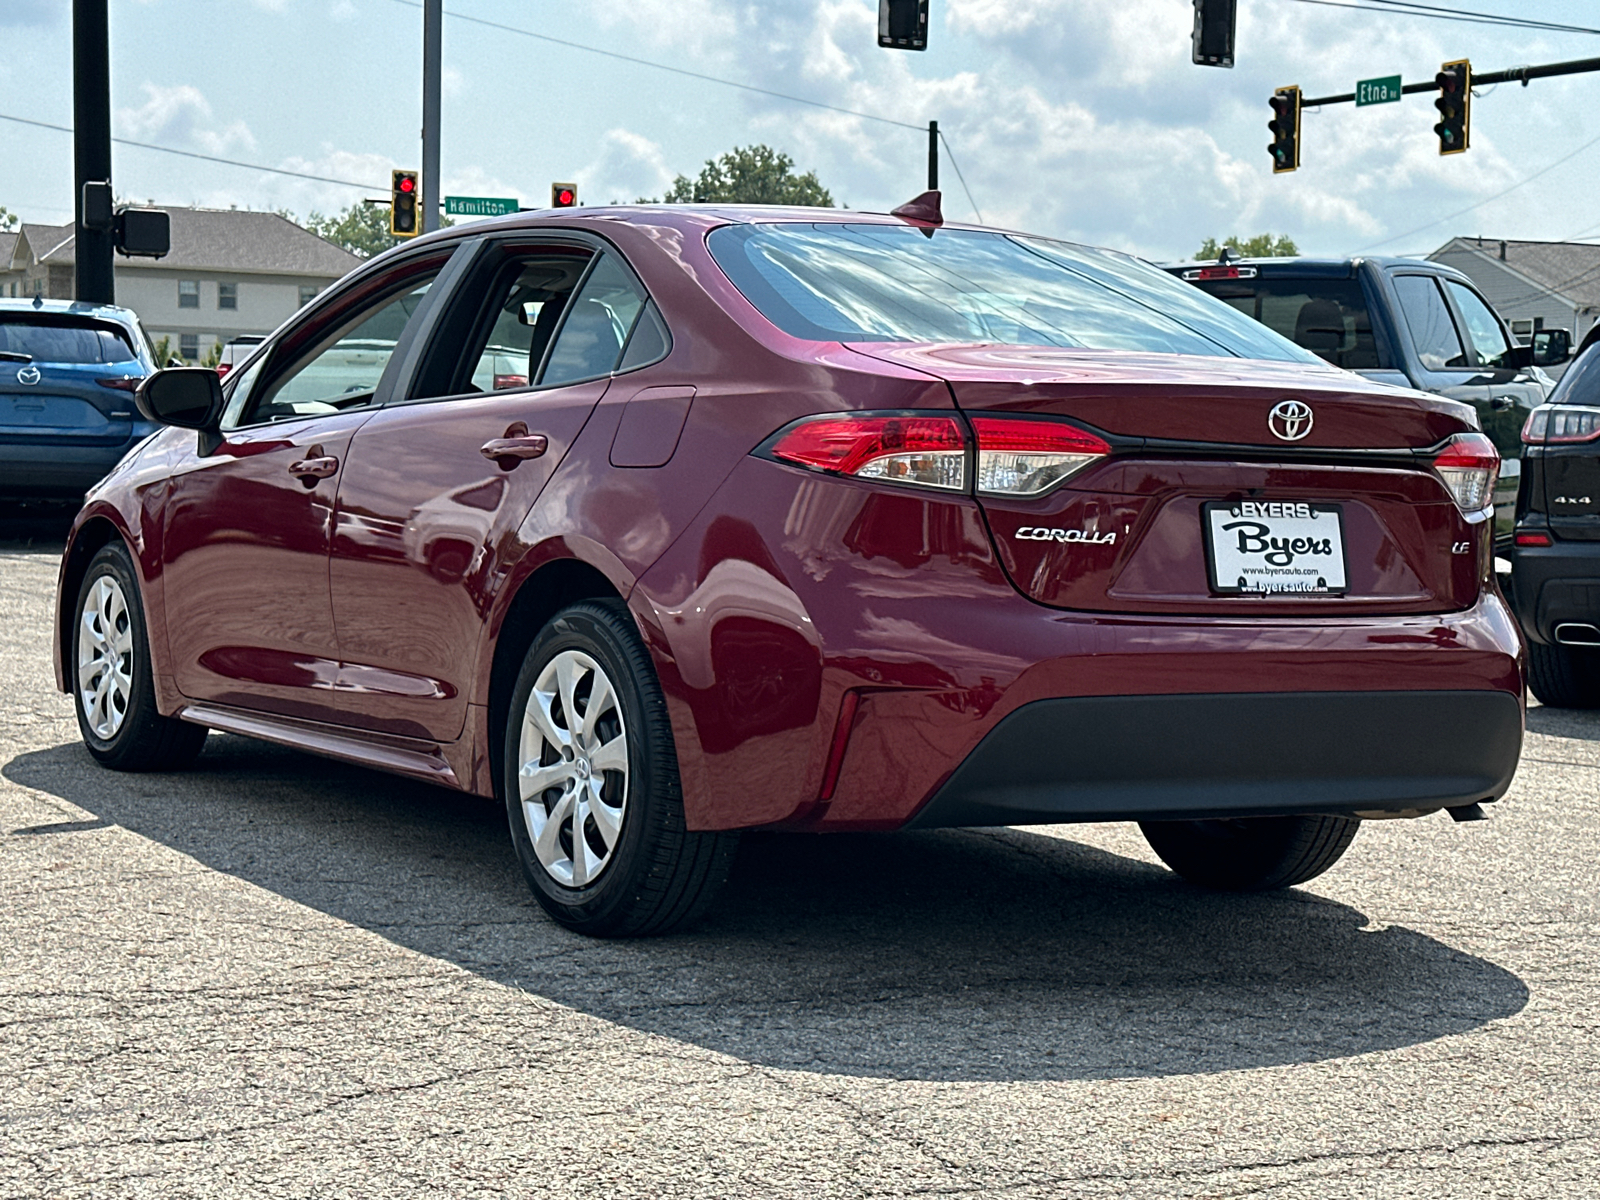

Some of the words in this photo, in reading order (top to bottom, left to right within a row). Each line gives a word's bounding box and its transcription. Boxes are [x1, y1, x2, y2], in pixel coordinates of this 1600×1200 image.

[1360, 83, 1388, 103] Etna
[450, 199, 505, 214] Hamilton
[1554, 496, 1592, 504] 4x4
[1241, 502, 1310, 518] BYERS
[1015, 527, 1117, 545] COROLLA
[1222, 521, 1333, 566] Byers
[1452, 542, 1470, 554] LE
[1242, 566, 1319, 577] www.byersauto.com
